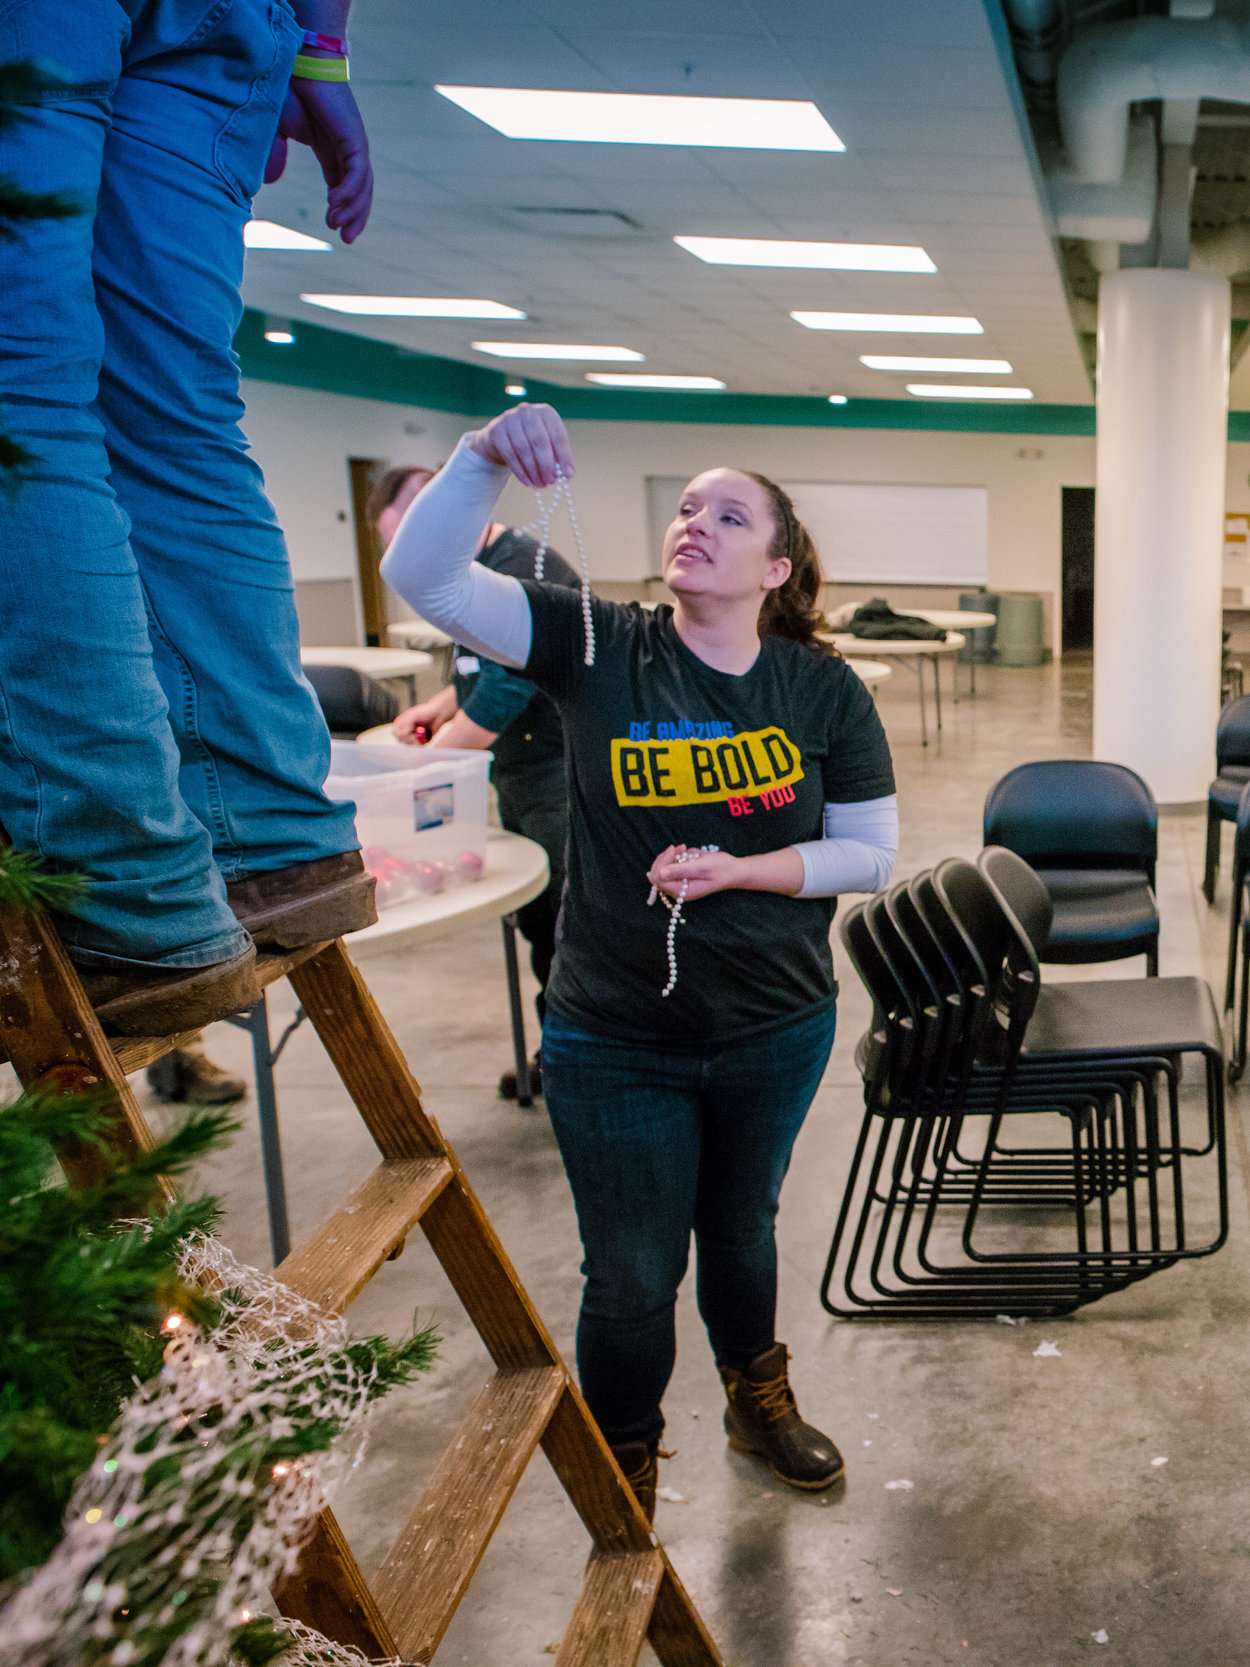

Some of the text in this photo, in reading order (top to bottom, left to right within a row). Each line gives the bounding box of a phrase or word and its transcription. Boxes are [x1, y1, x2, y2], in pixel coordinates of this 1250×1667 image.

[630, 720, 735, 742] BE AMAZING
[620, 734, 794, 797] BE BOLD
[728, 783, 796, 817] BE YOU
